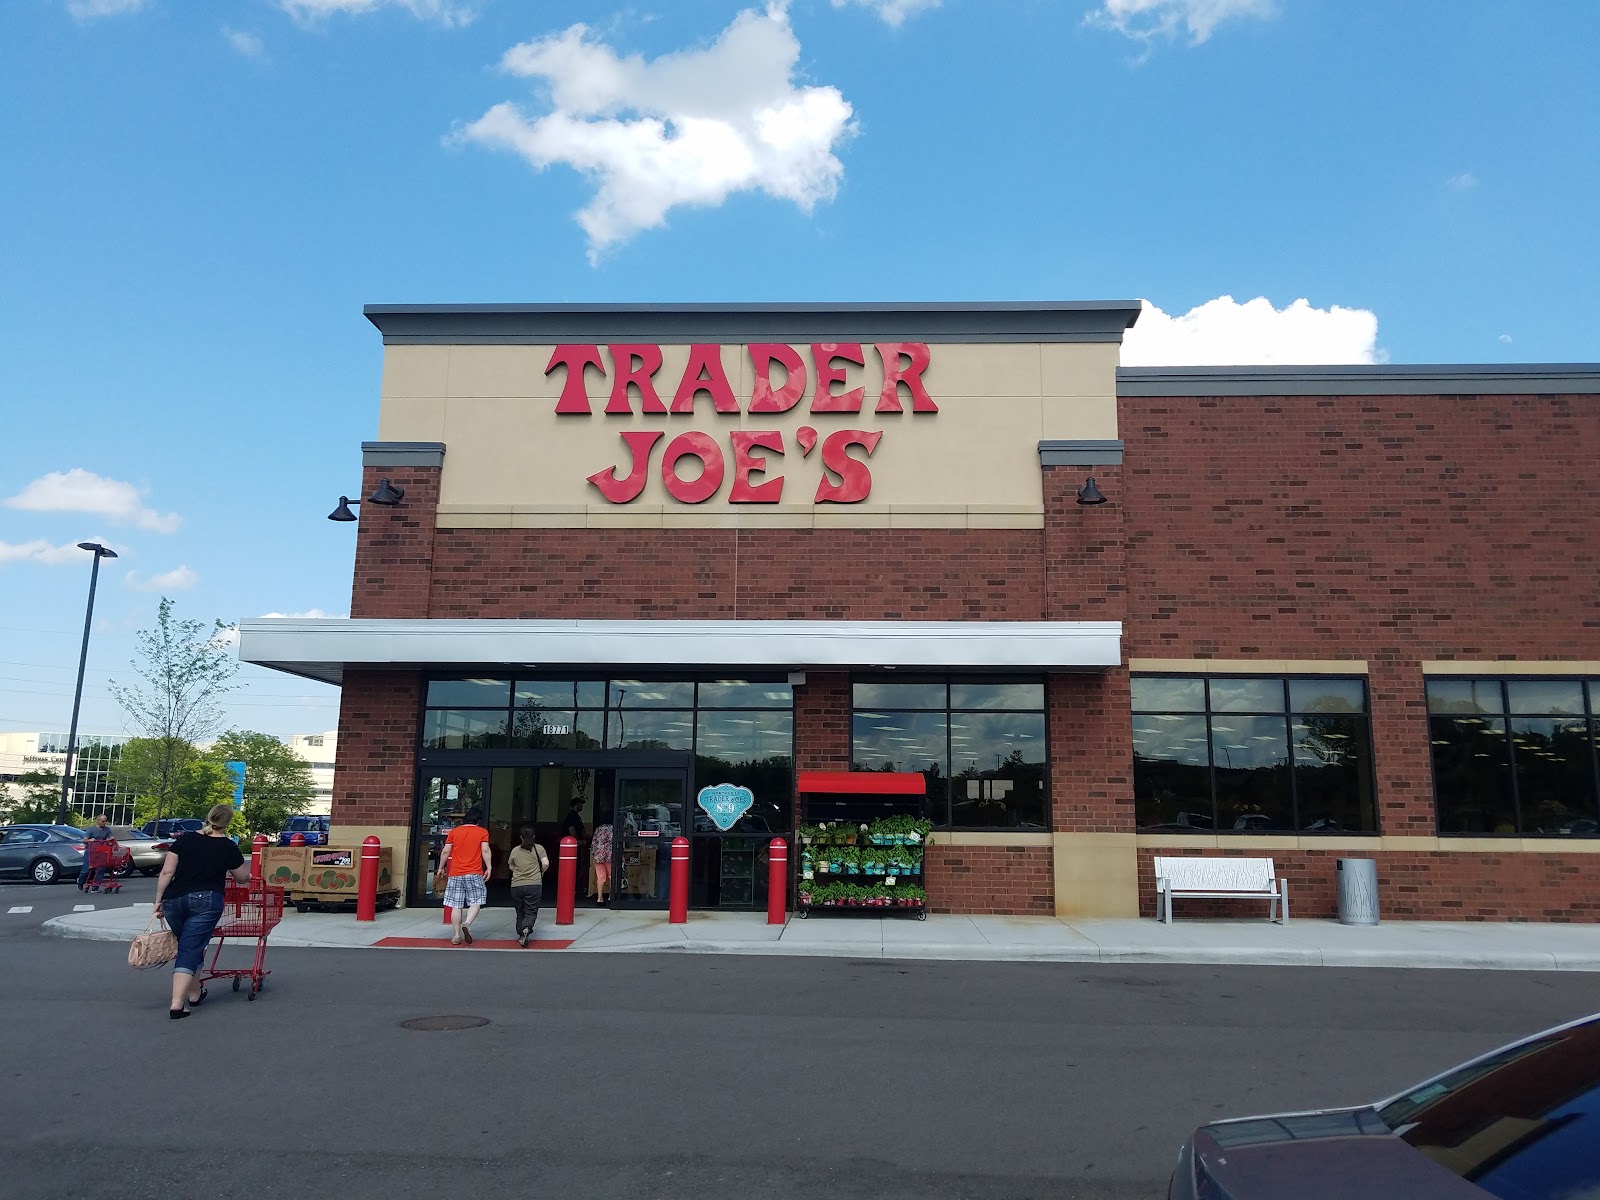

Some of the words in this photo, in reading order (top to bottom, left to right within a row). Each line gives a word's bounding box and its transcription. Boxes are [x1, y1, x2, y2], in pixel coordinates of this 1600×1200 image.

[544, 343, 939, 415] TRADER
[586, 425, 884, 505] JOE'S
[544, 725, 568, 734] 18771
